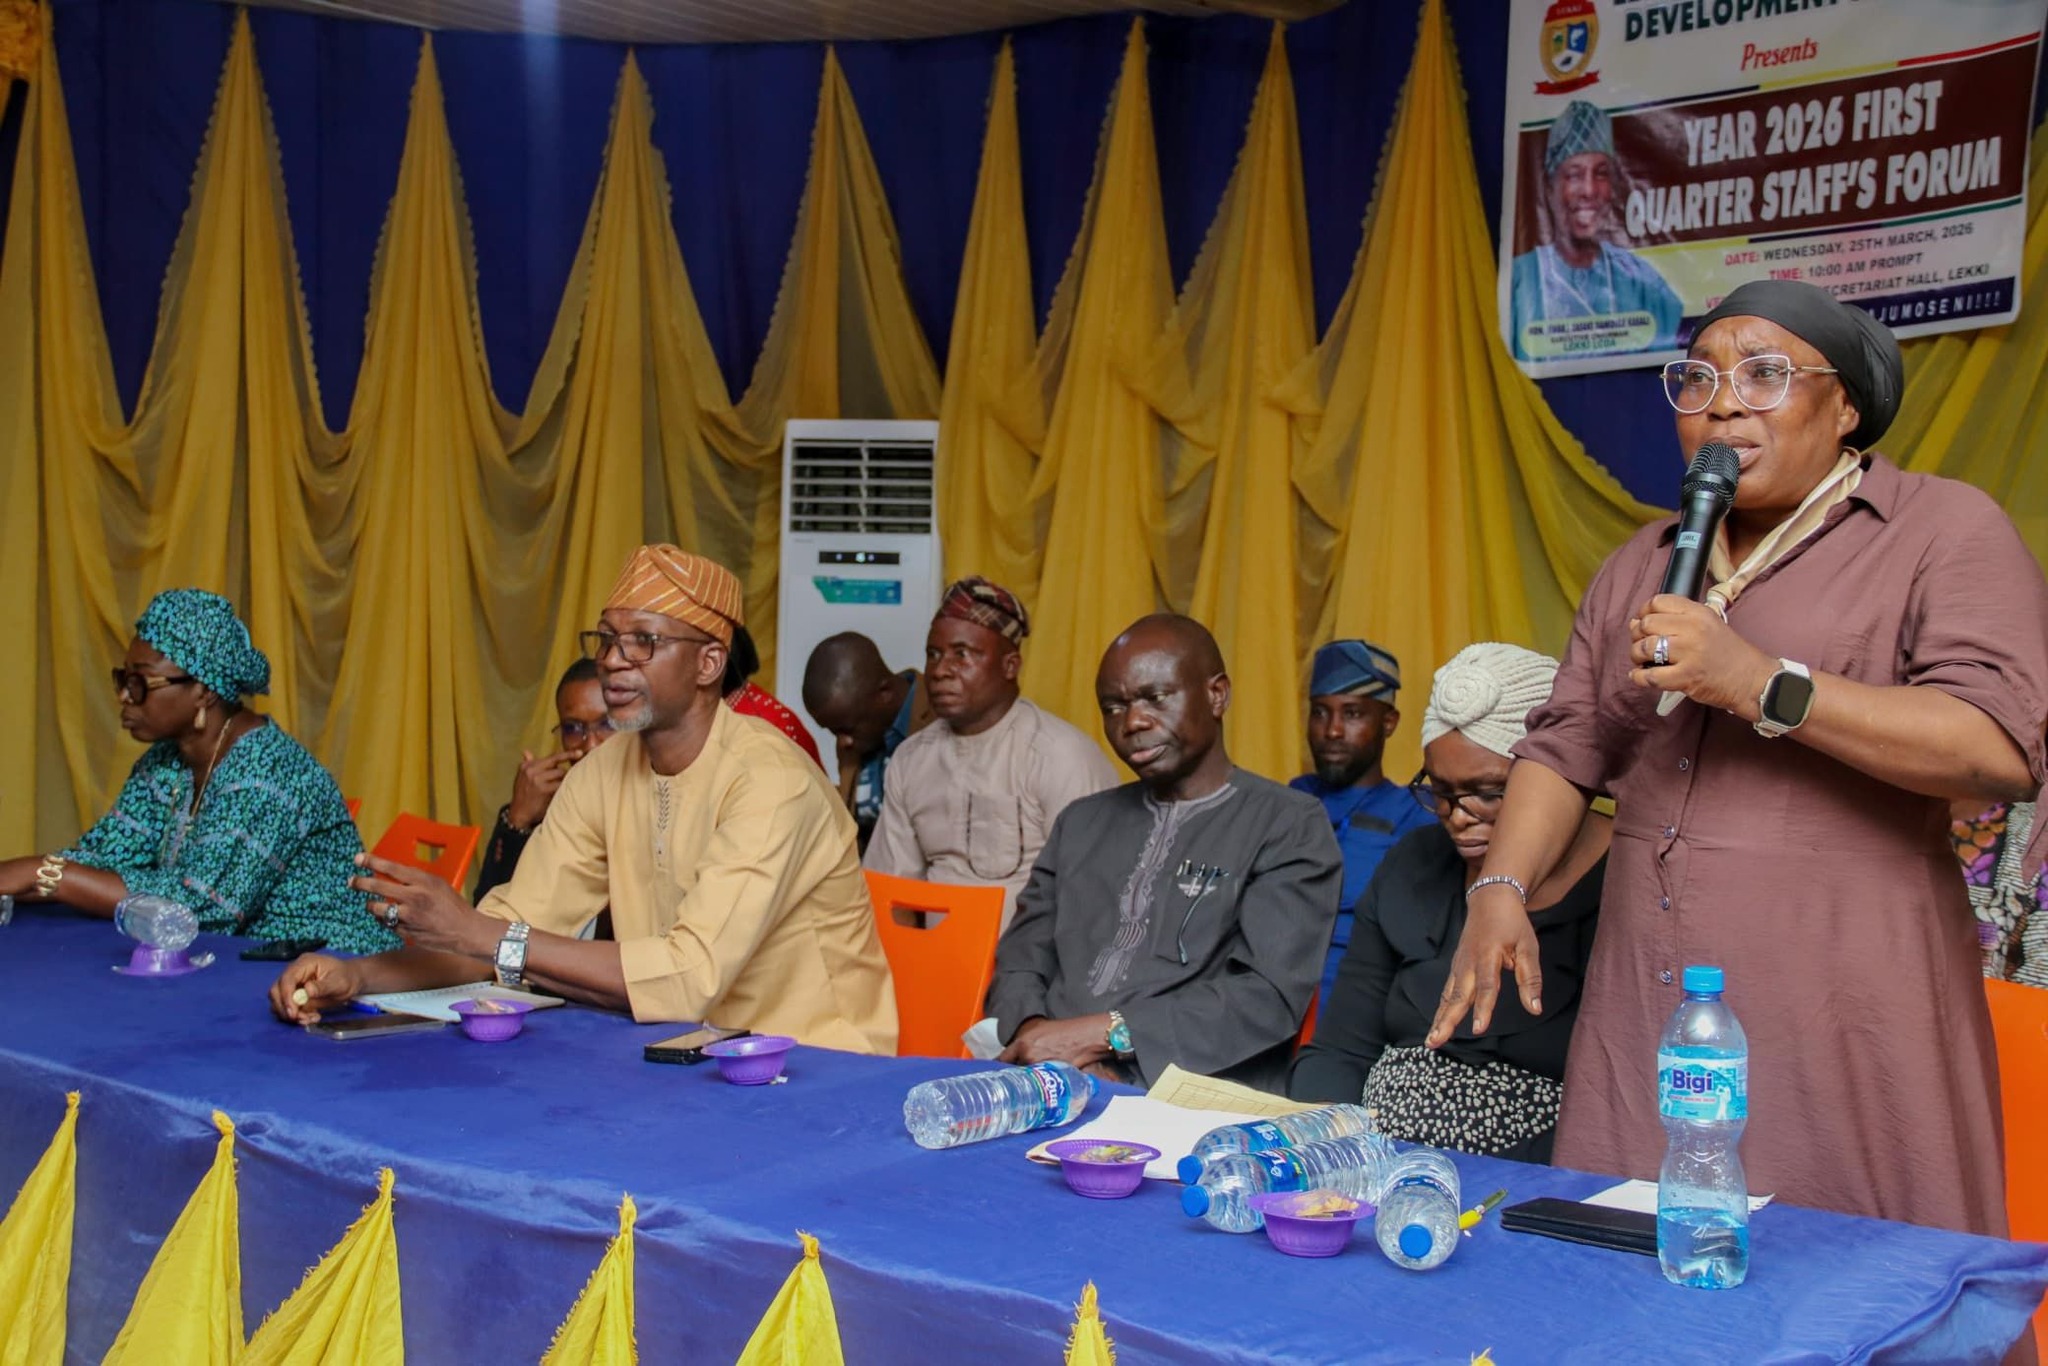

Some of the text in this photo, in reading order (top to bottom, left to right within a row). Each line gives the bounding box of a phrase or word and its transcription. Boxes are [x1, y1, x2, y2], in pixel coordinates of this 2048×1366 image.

[1625, 0, 1838, 41] DEVELOPM
[1741, 38, 1819, 71] Presents
[1684, 80, 1944, 167] YEAR 2026 FIRST
[1625, 136, 2002, 238] QUARTER STAFF'S FORUM
[1725, 252, 1759, 266] DATE:
[1850, 238, 1883, 252] 25TH
[1887, 229, 1937, 247] MARCH,
[1941, 222, 1974, 239] 2026
[1769, 252, 1923, 280] TIME: 10:00 AM PROMPT
[1822, 277, 1902, 295] ECRETARIAT
[1948, 264, 1990, 280] LEKKI
[1673, 1069, 1713, 1094] Bigi
